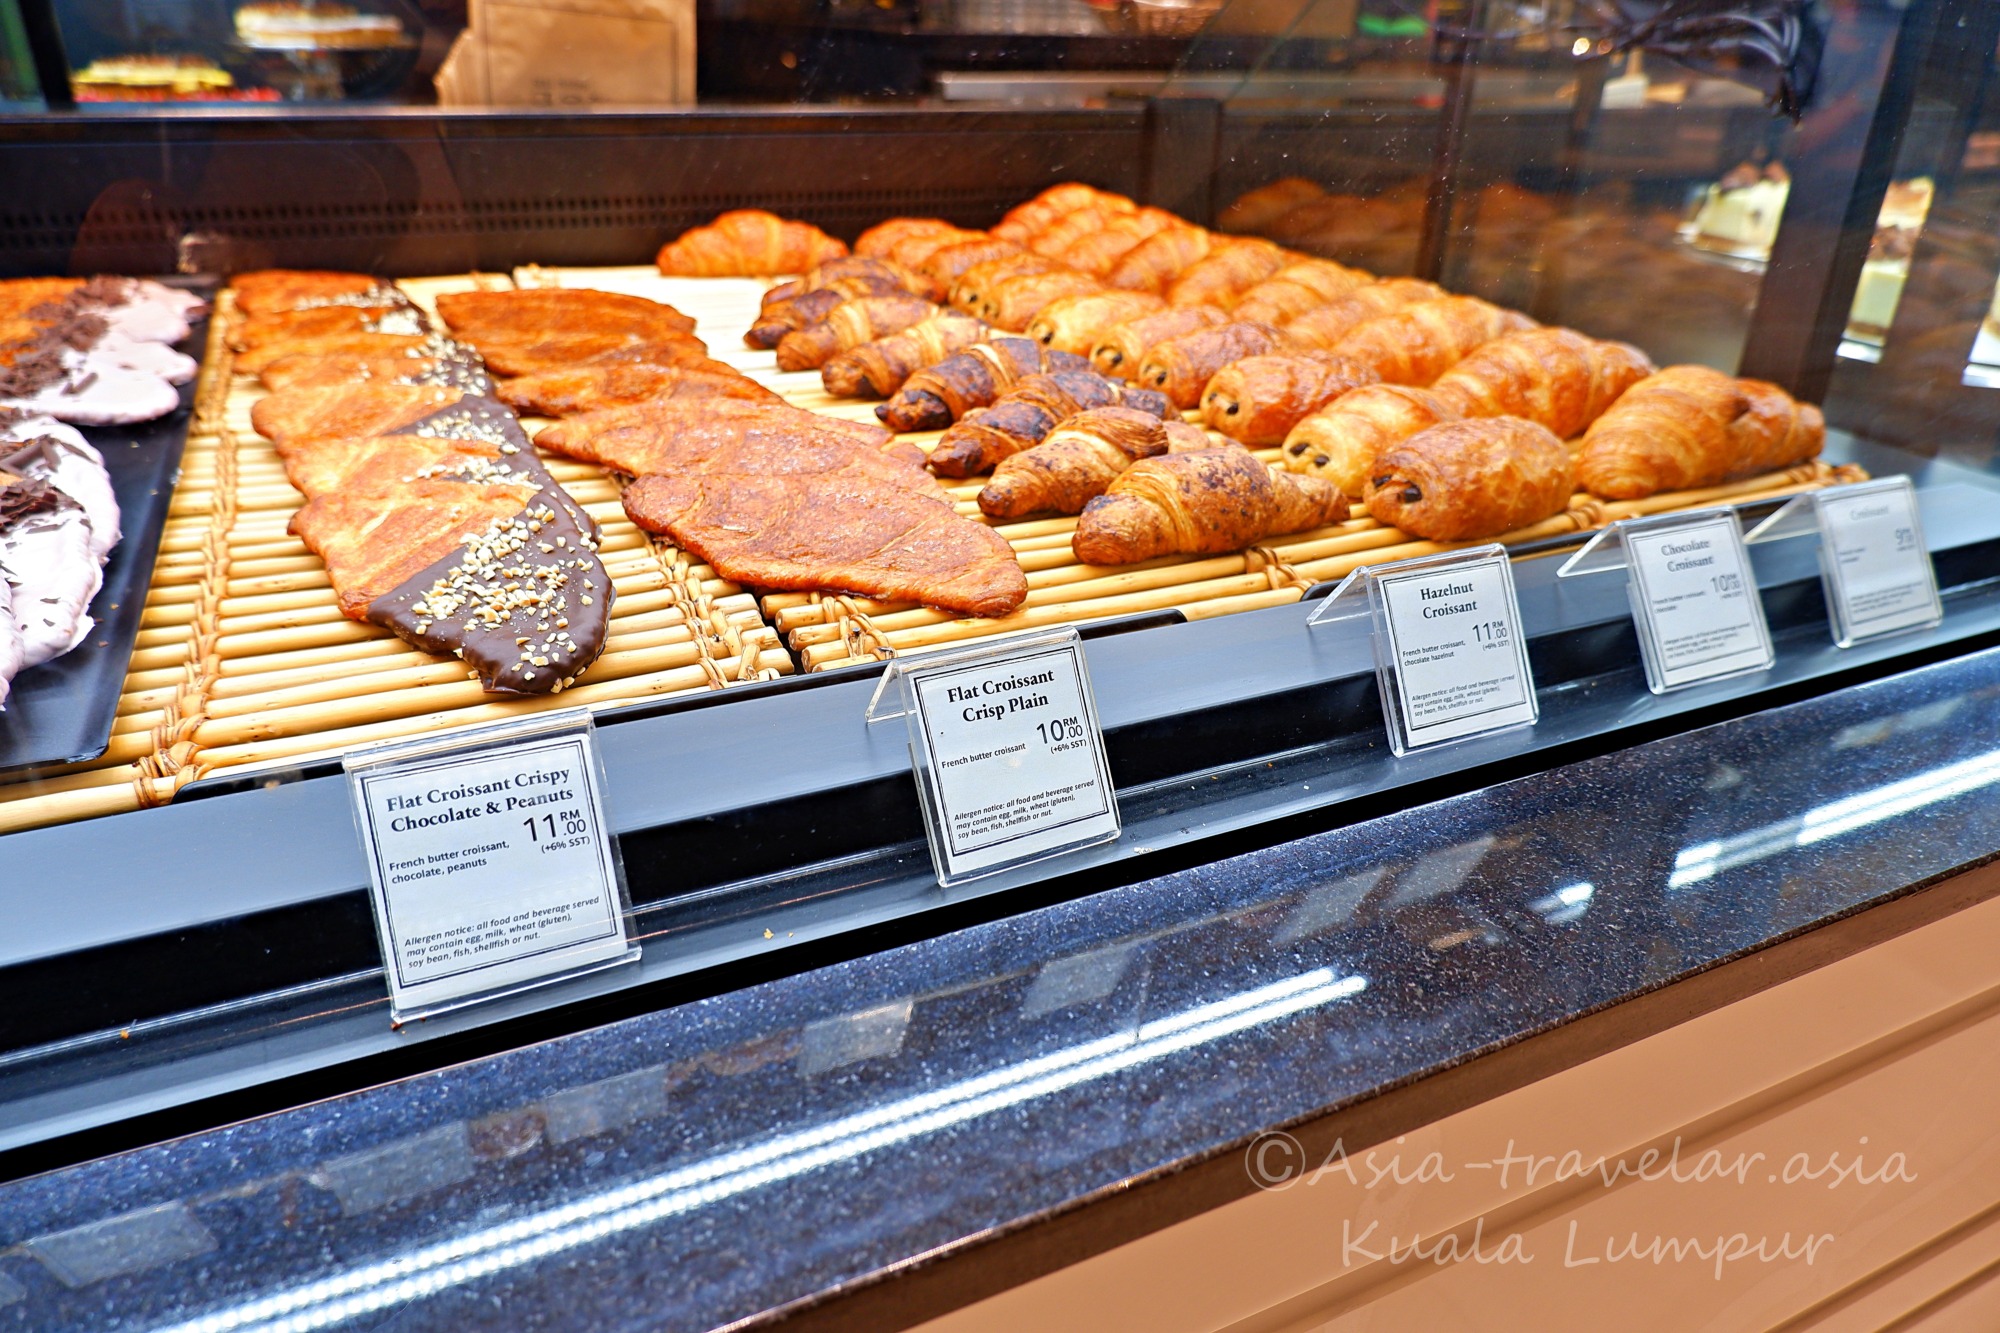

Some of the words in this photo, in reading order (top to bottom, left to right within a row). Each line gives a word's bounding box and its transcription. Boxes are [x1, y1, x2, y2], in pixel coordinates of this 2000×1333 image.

[1661, 540, 1710, 556] Chocolate
[1667, 556, 1714, 572] Croissant
[1420, 582, 1473, 600] Hazelnut
[1710, 575, 1728, 592] 10
[1423, 601, 1477, 619] Croissant
[1472, 623, 1491, 642] 11
[1492, 620, 1503, 628] RM
[1403, 648, 1420, 657] French
[1422, 645, 1438, 653] butter
[1404, 656, 1429, 666] chocolate
[1431, 652, 1454, 661] hazelnut
[947, 686, 979, 703] Flat
[982, 670, 1054, 694] Croissant
[962, 704, 1005, 722] Crisp
[1008, 693, 1049, 712] Plain
[1036, 720, 1064, 744] 10
[1063, 716, 1078, 726] RM
[942, 756, 968, 768] French
[970, 752, 992, 762] butter
[994, 743, 1026, 756] croissant
[1051, 744, 1069, 754] (+6%
[1071, 739, 1086, 749] SST)
[386, 796, 423, 812] Flat
[427, 778, 511, 804] Croissant
[515, 769, 570, 788] Crispy
[954, 810, 981, 821] Allergen
[983, 804, 1005, 814] notice:
[1016, 796, 1030, 806] food
[1032, 793, 1044, 801] and
[1046, 786, 1073, 797] beverage
[1075, 780, 1094, 790] served
[391, 804, 481, 833] Chocolate
[486, 802, 502, 815] &
[506, 789, 574, 812] Peanuts
[560, 809, 581, 822] RM
[971, 828, 989, 836] bean,
[990, 823, 1004, 831] fish,
[1006, 815, 1031, 827] shellfish
[1041, 809, 1053, 817] nut.
[973, 815, 997, 826] contain
[999, 812, 1012, 820] egg,
[1013, 807, 1028, 816] milk,
[1030, 801, 1049, 810] wheat
[523, 813, 557, 842] 11
[563, 819, 586, 836] .00
[389, 857, 425, 871] French
[428, 850, 459, 864] butter
[462, 840, 510, 857] croissant,
[541, 841, 566, 854] (+6%
[569, 836, 591, 848] SST)
[392, 867, 445, 884] chocolate,
[447, 857, 487, 875] peanuts
[405, 933, 442, 947] Allergen
[445, 924, 475, 937] notice:
[477, 921, 488, 930] all
[490, 917, 511, 927] food
[513, 912, 530, 922] and
[532, 904, 571, 918] beverage
[573, 896, 599, 909] served
[407, 948, 426, 957] may
[429, 939, 463, 953] contain
[466, 936, 484, 945] egg,
[486, 928, 506, 940] milk,
[509, 922, 536, 933] wheat
[408, 960, 424, 968] soy
[427, 954, 452, 964] bean,
[454, 948, 472, 958] fish,
[474, 939, 510, 954] shellfish
[524, 932, 541, 941] nut.
